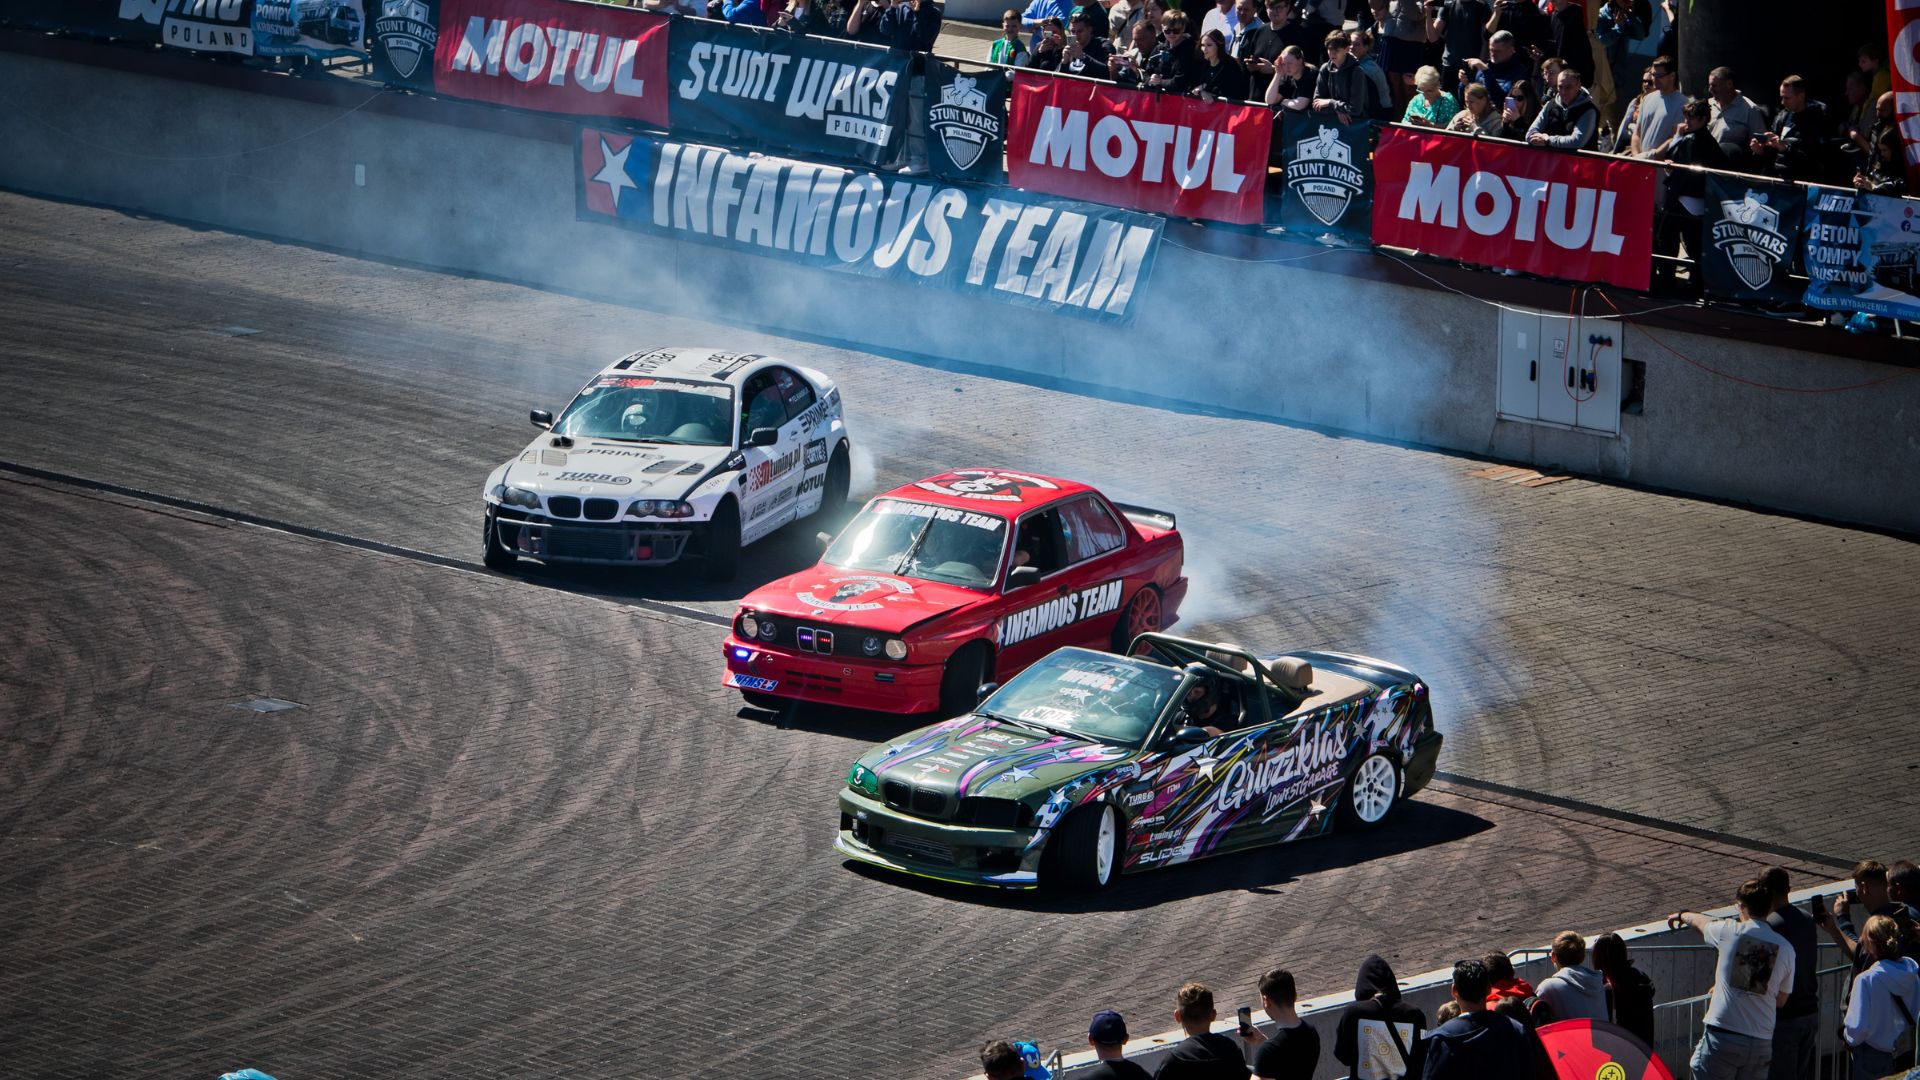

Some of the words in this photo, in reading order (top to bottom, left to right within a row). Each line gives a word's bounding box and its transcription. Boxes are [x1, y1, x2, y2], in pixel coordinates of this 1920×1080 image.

[255, 4, 291, 22] POMPY
[171, 25, 247, 48] POLAND
[375, 20, 404, 34] STUNT
[407, 21, 438, 43] WARS
[452, 16, 644, 97] MOTUL
[679, 41, 791, 103] STUNT
[785, 57, 898, 121] WARS
[834, 119, 884, 140] POLAND
[929, 108, 960, 121] STUNT
[962, 111, 999, 133] WARS
[1029, 105, 1245, 194] MOTUL
[1288, 163, 1326, 179] STUNT
[1328, 165, 1364, 187] WARS
[1312, 184, 1336, 193] POLAND
[1397, 161, 1625, 257] MOTUL
[653, 143, 967, 276] INFAMOUS
[965, 198, 1154, 315] TEAM
[1810, 223, 1859, 245] BETON
[1747, 229, 1788, 256] WARS
[1808, 244, 1862, 267] POMPY
[795, 472, 825, 498] MOTUL
[961, 512, 1002, 532] TEAM
[1004, 592, 1079, 647] INFAMOUS
[1080, 579, 1123, 620] TEAM
[1138, 846, 1184, 864] SLIDE
